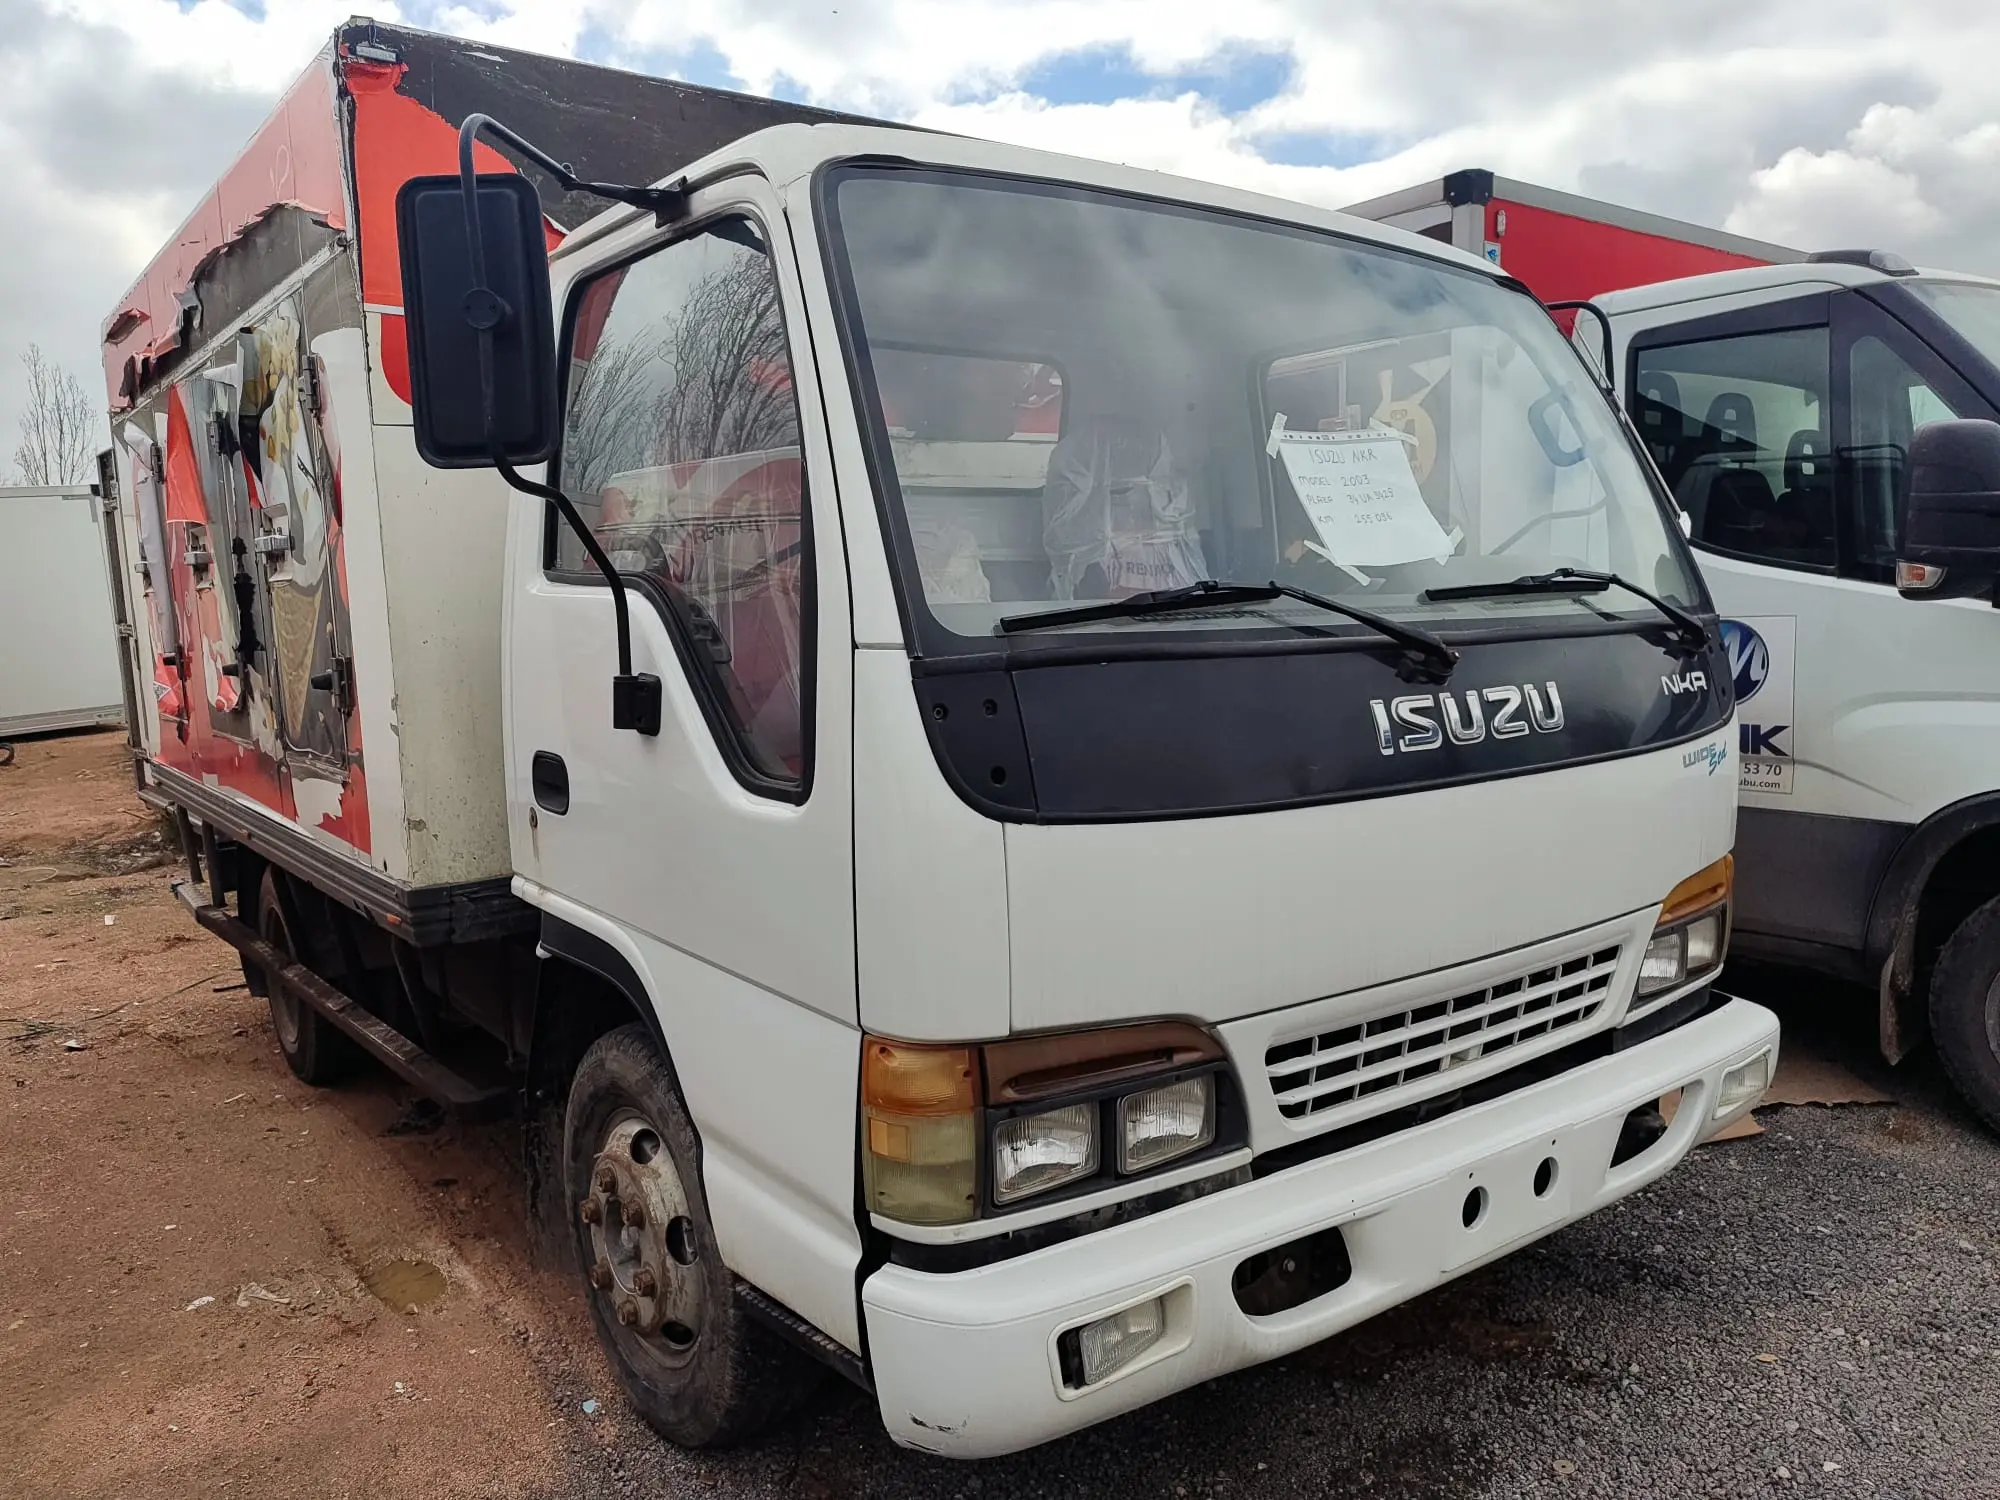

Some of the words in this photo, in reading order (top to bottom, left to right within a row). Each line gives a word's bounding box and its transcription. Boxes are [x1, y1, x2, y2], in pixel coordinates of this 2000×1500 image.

[1308, 446, 1346, 464] ISUZU
[1352, 448, 1378, 463] NKR
[1340, 473, 1370, 487] 2003
[1370, 680, 1566, 756] ISUZU
[1743, 762, 1760, 775] 53
[1765, 764, 1782, 776] 70
